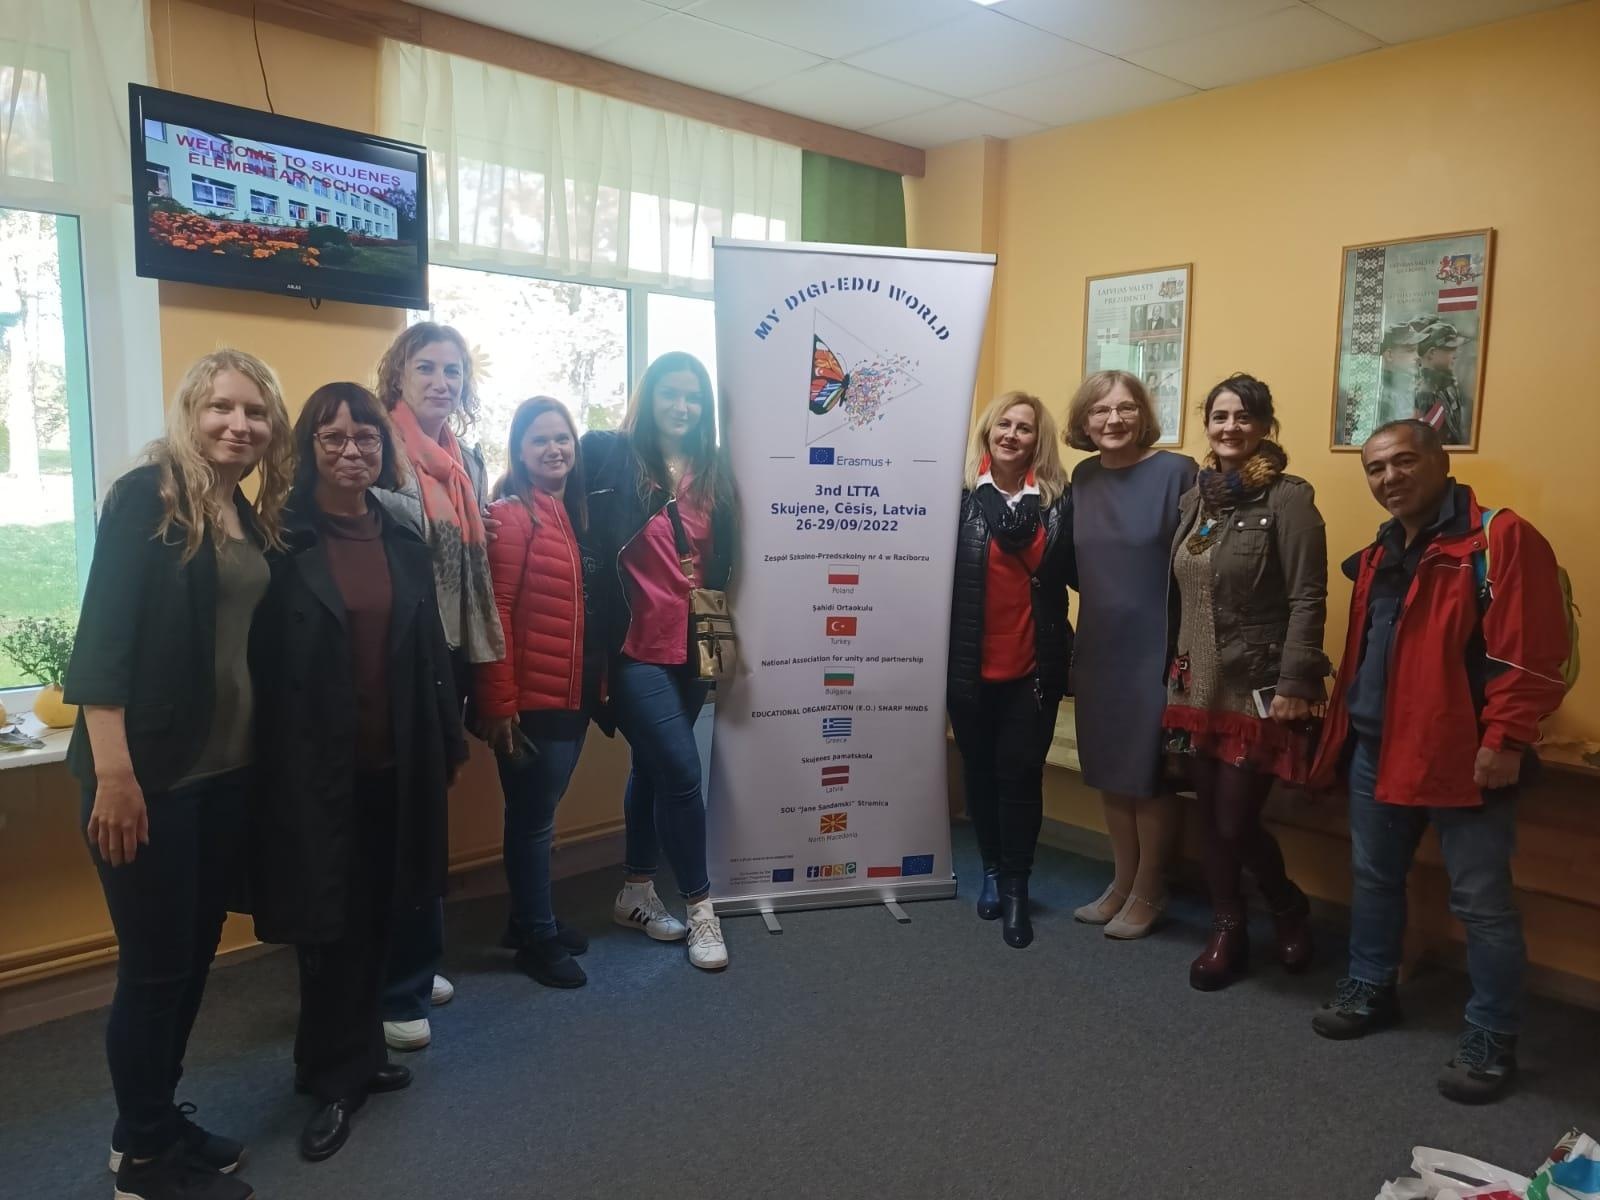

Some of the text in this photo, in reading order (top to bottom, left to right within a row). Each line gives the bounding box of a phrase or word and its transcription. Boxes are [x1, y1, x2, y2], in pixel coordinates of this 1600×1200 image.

[176, 133, 401, 187] WELCOME TO SKUJENES
[188, 152, 395, 199] ELEMENTARY SCHOOL
[754, 277, 950, 341] MY DIGI-EDU WORLD
[836, 455, 893, 468] Erasmus+
[815, 484, 880, 498] 3nd LTTA
[770, 502, 927, 517] Skujene, Cēsis, Latvia
[796, 518, 898, 532] 26-29/09/2022
[893, 553, 930, 562] Raciborzu
[836, 604, 873, 612] Ortaokulu
[830, 638, 851, 646] Turkey
[761, 658, 791, 667] National
[792, 655, 831, 665] Association
[844, 655, 864, 663] unity
[881, 655, 924, 664] partnership
[751, 708, 801, 718] EDUCATIONAL
[802, 704, 854, 714] ORGANIZATION
[878, 704, 903, 712] SHARP
[904, 704, 929, 712] MINDS
[826, 786, 844, 794] Latvia
[780, 806, 796, 814] SOU
